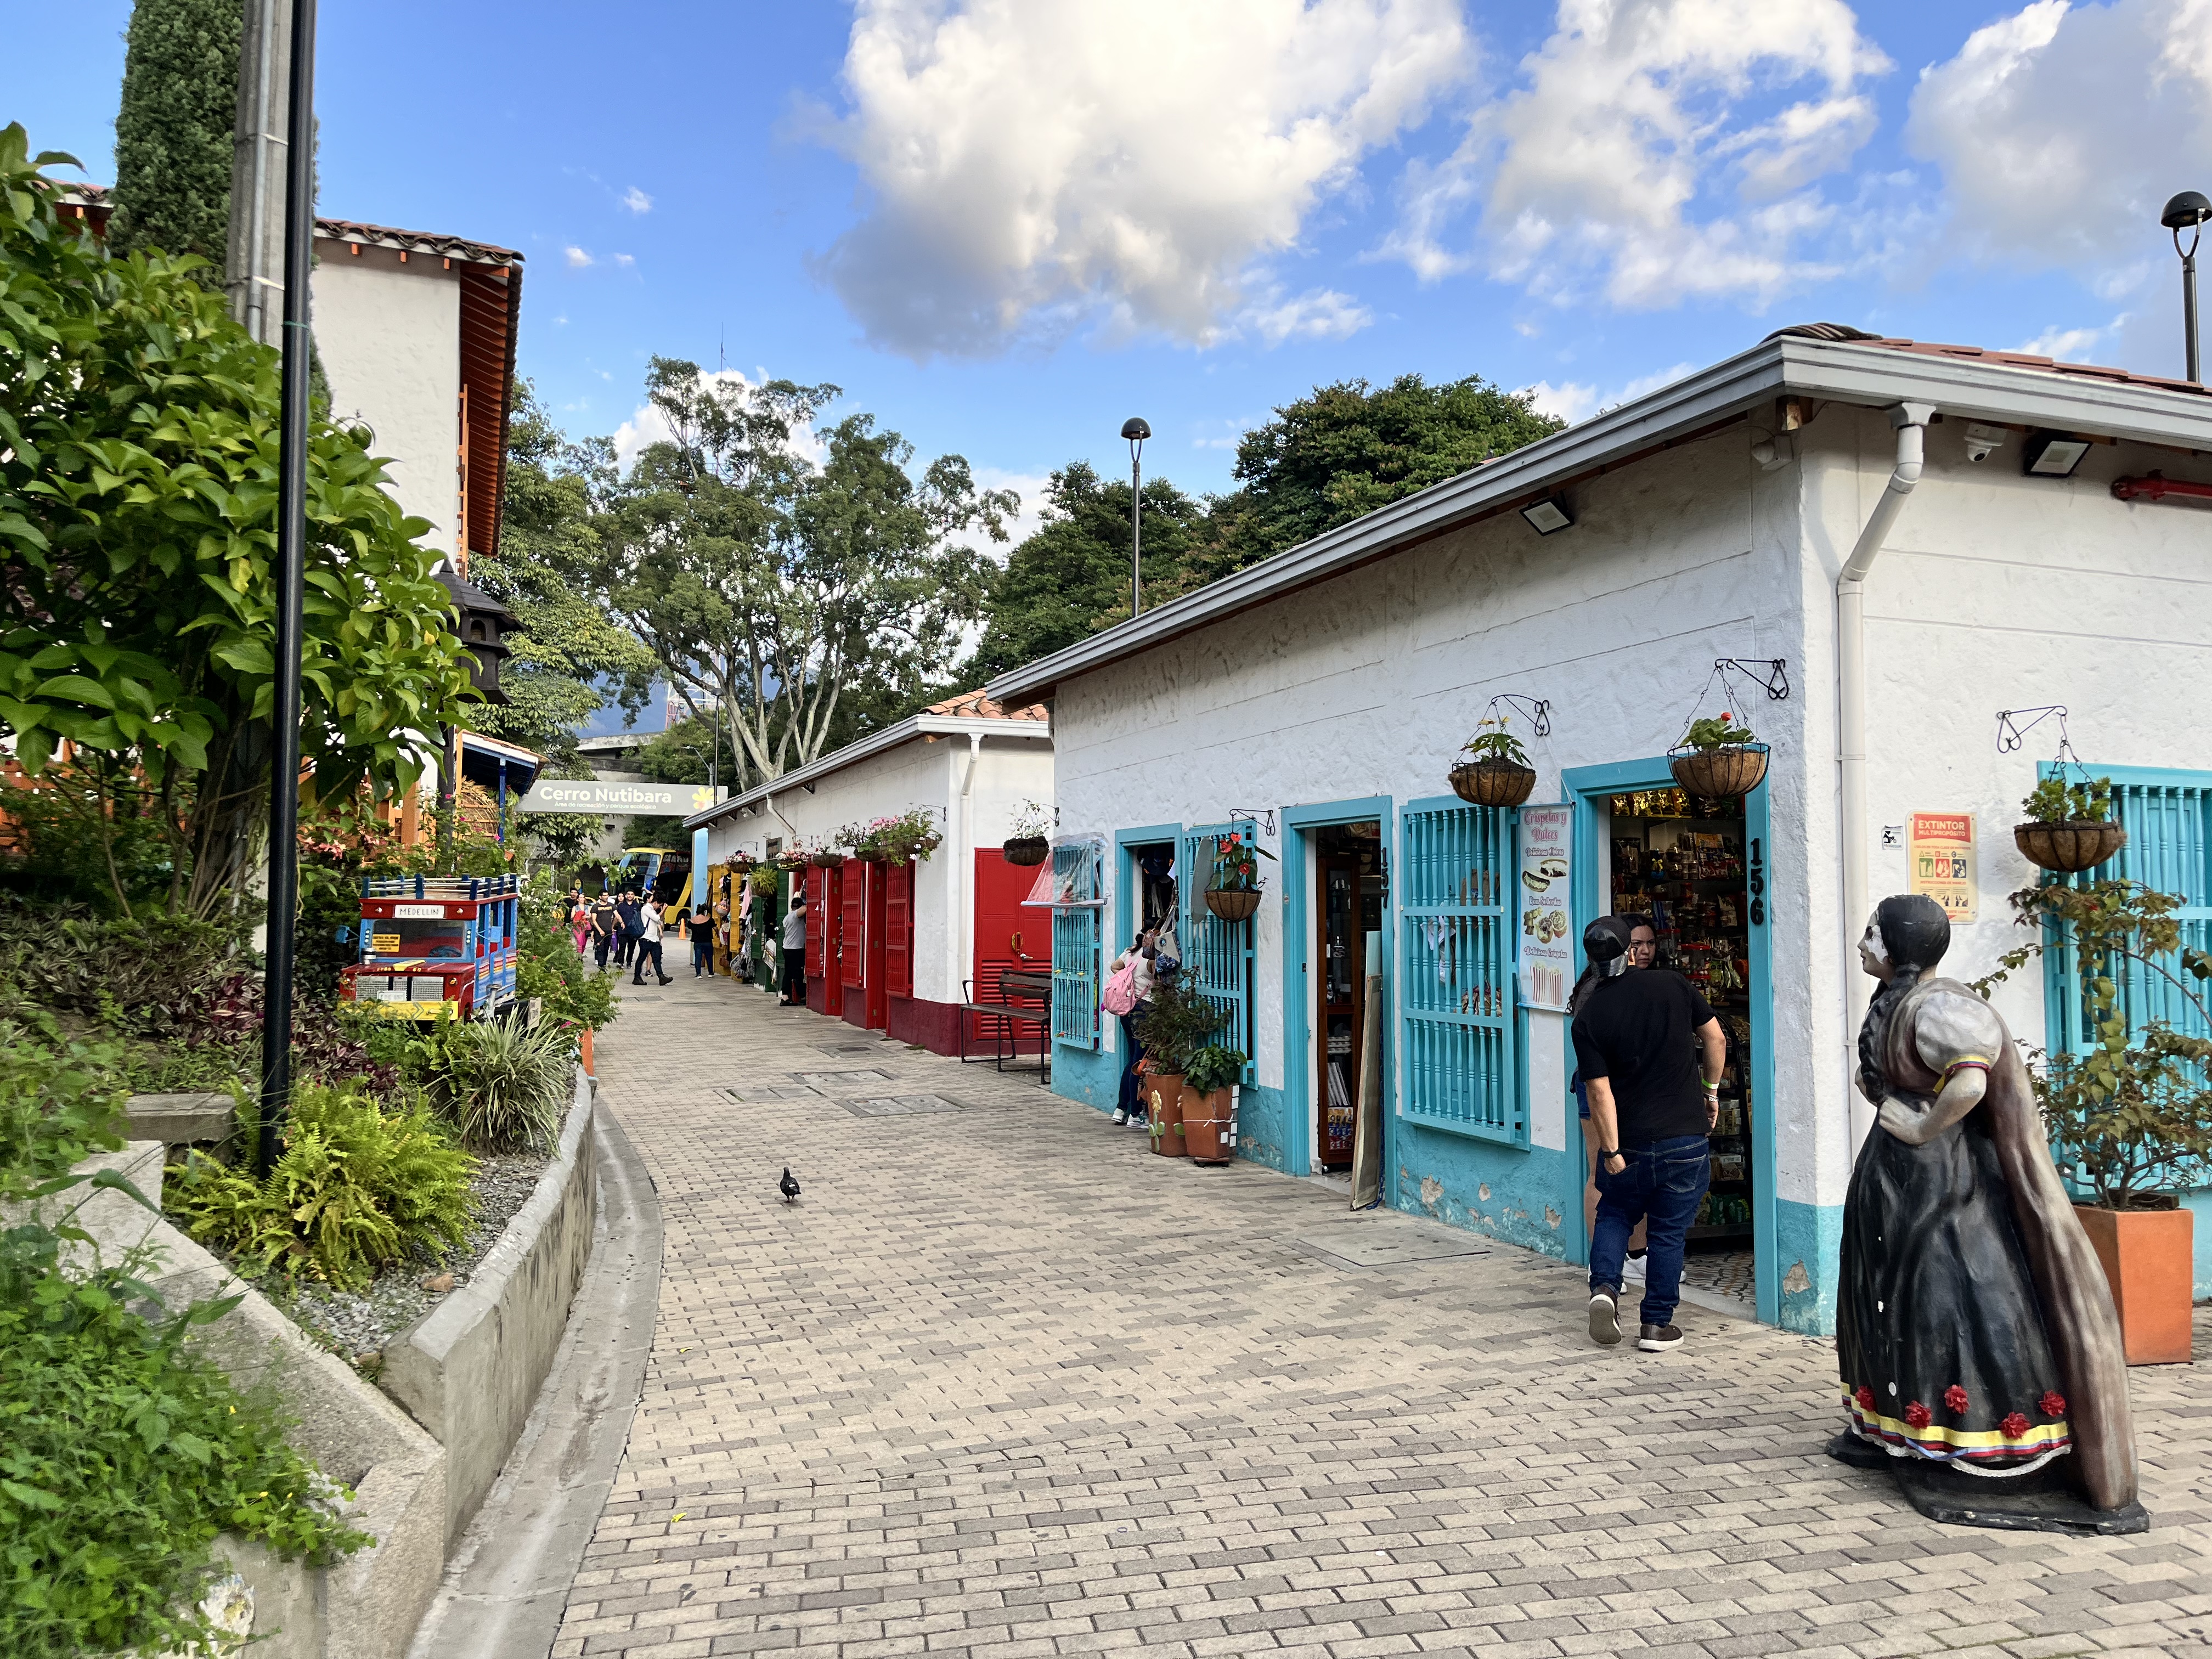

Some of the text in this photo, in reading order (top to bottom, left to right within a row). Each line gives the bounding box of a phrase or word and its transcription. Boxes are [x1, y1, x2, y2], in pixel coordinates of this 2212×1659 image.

[540, 786, 672, 803] Cerro Nutibara
[1525, 809, 1567, 827] Crispetas y
[1918, 820, 1965, 831] EXTINTOR
[1531, 827, 1559, 843] Dulces
[1381, 847, 1389, 909] 157
[1750, 838, 1764, 926] 156
